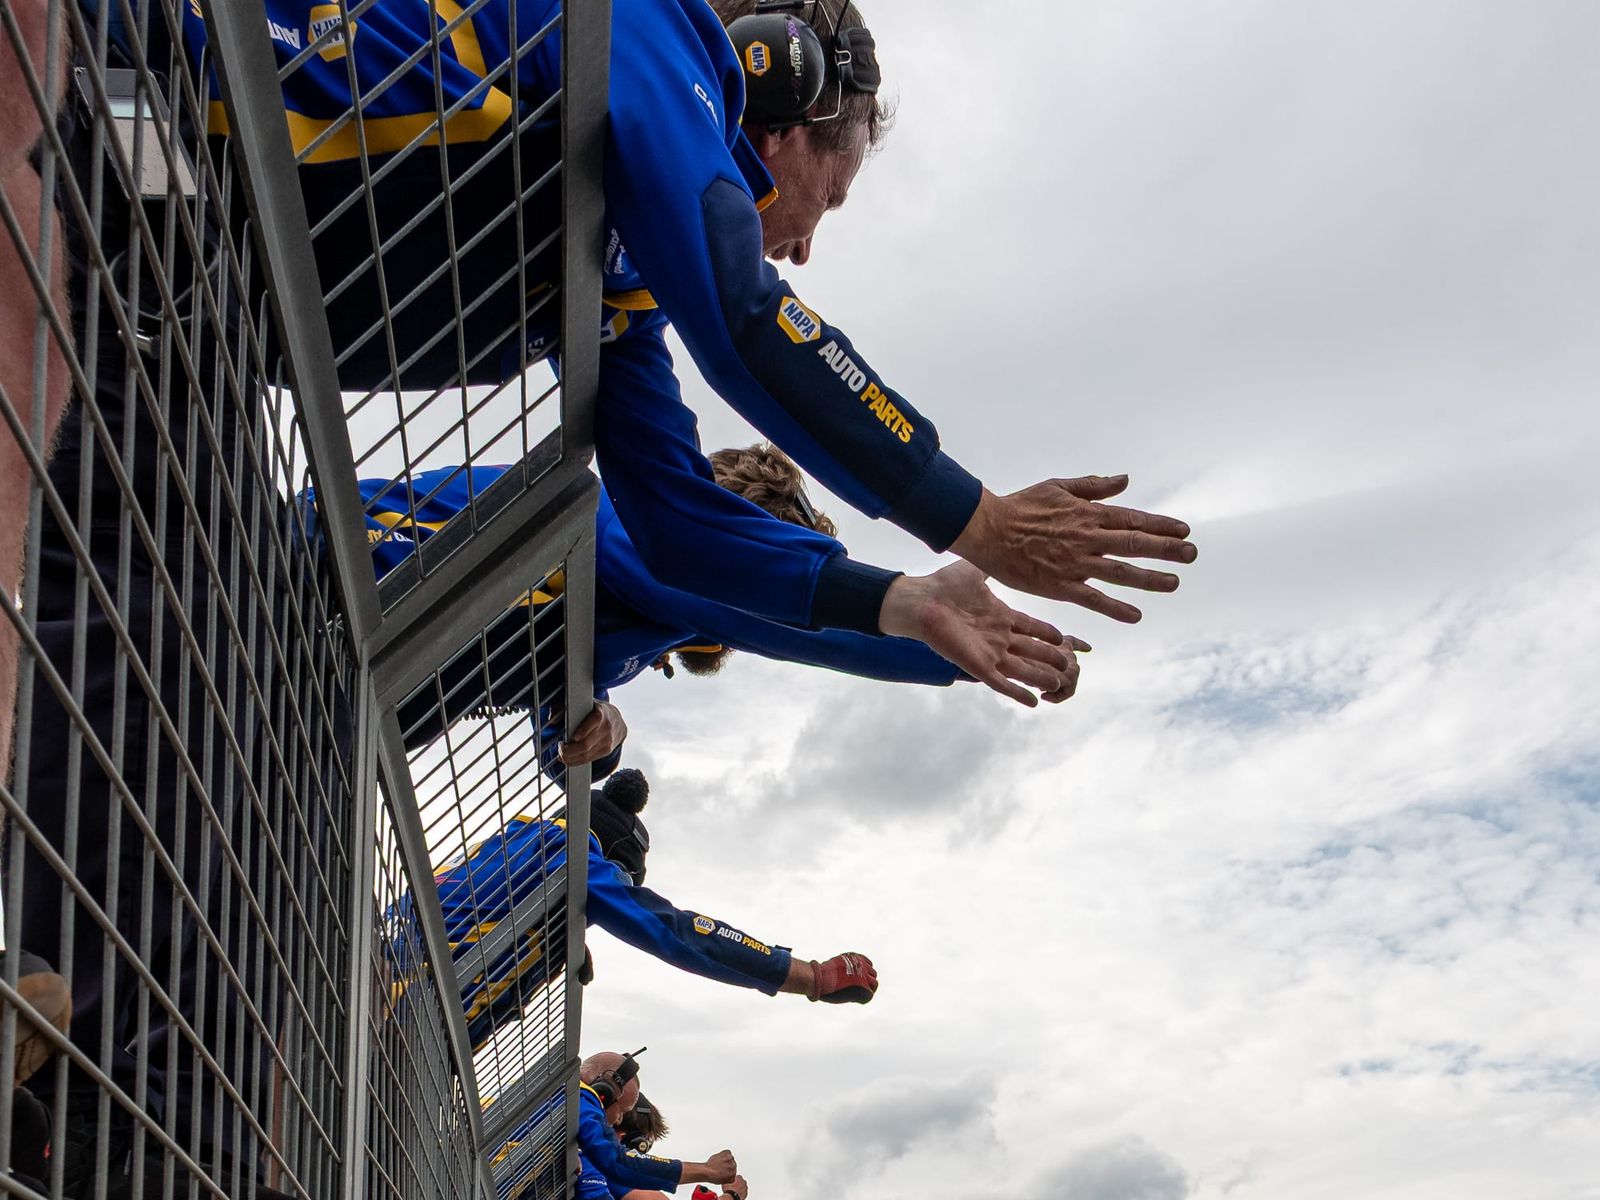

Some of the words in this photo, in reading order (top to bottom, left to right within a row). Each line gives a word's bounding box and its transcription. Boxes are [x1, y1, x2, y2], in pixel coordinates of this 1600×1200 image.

[751, 46, 765, 72] NAPA
[784, 302, 816, 338] NAPA
[817, 340, 867, 392] AUTO
[860, 382, 914, 443] PARTS
[696, 918, 713, 930] NAPA
[717, 926, 743, 942] AUTO
[742, 936, 772, 956] PARTS
